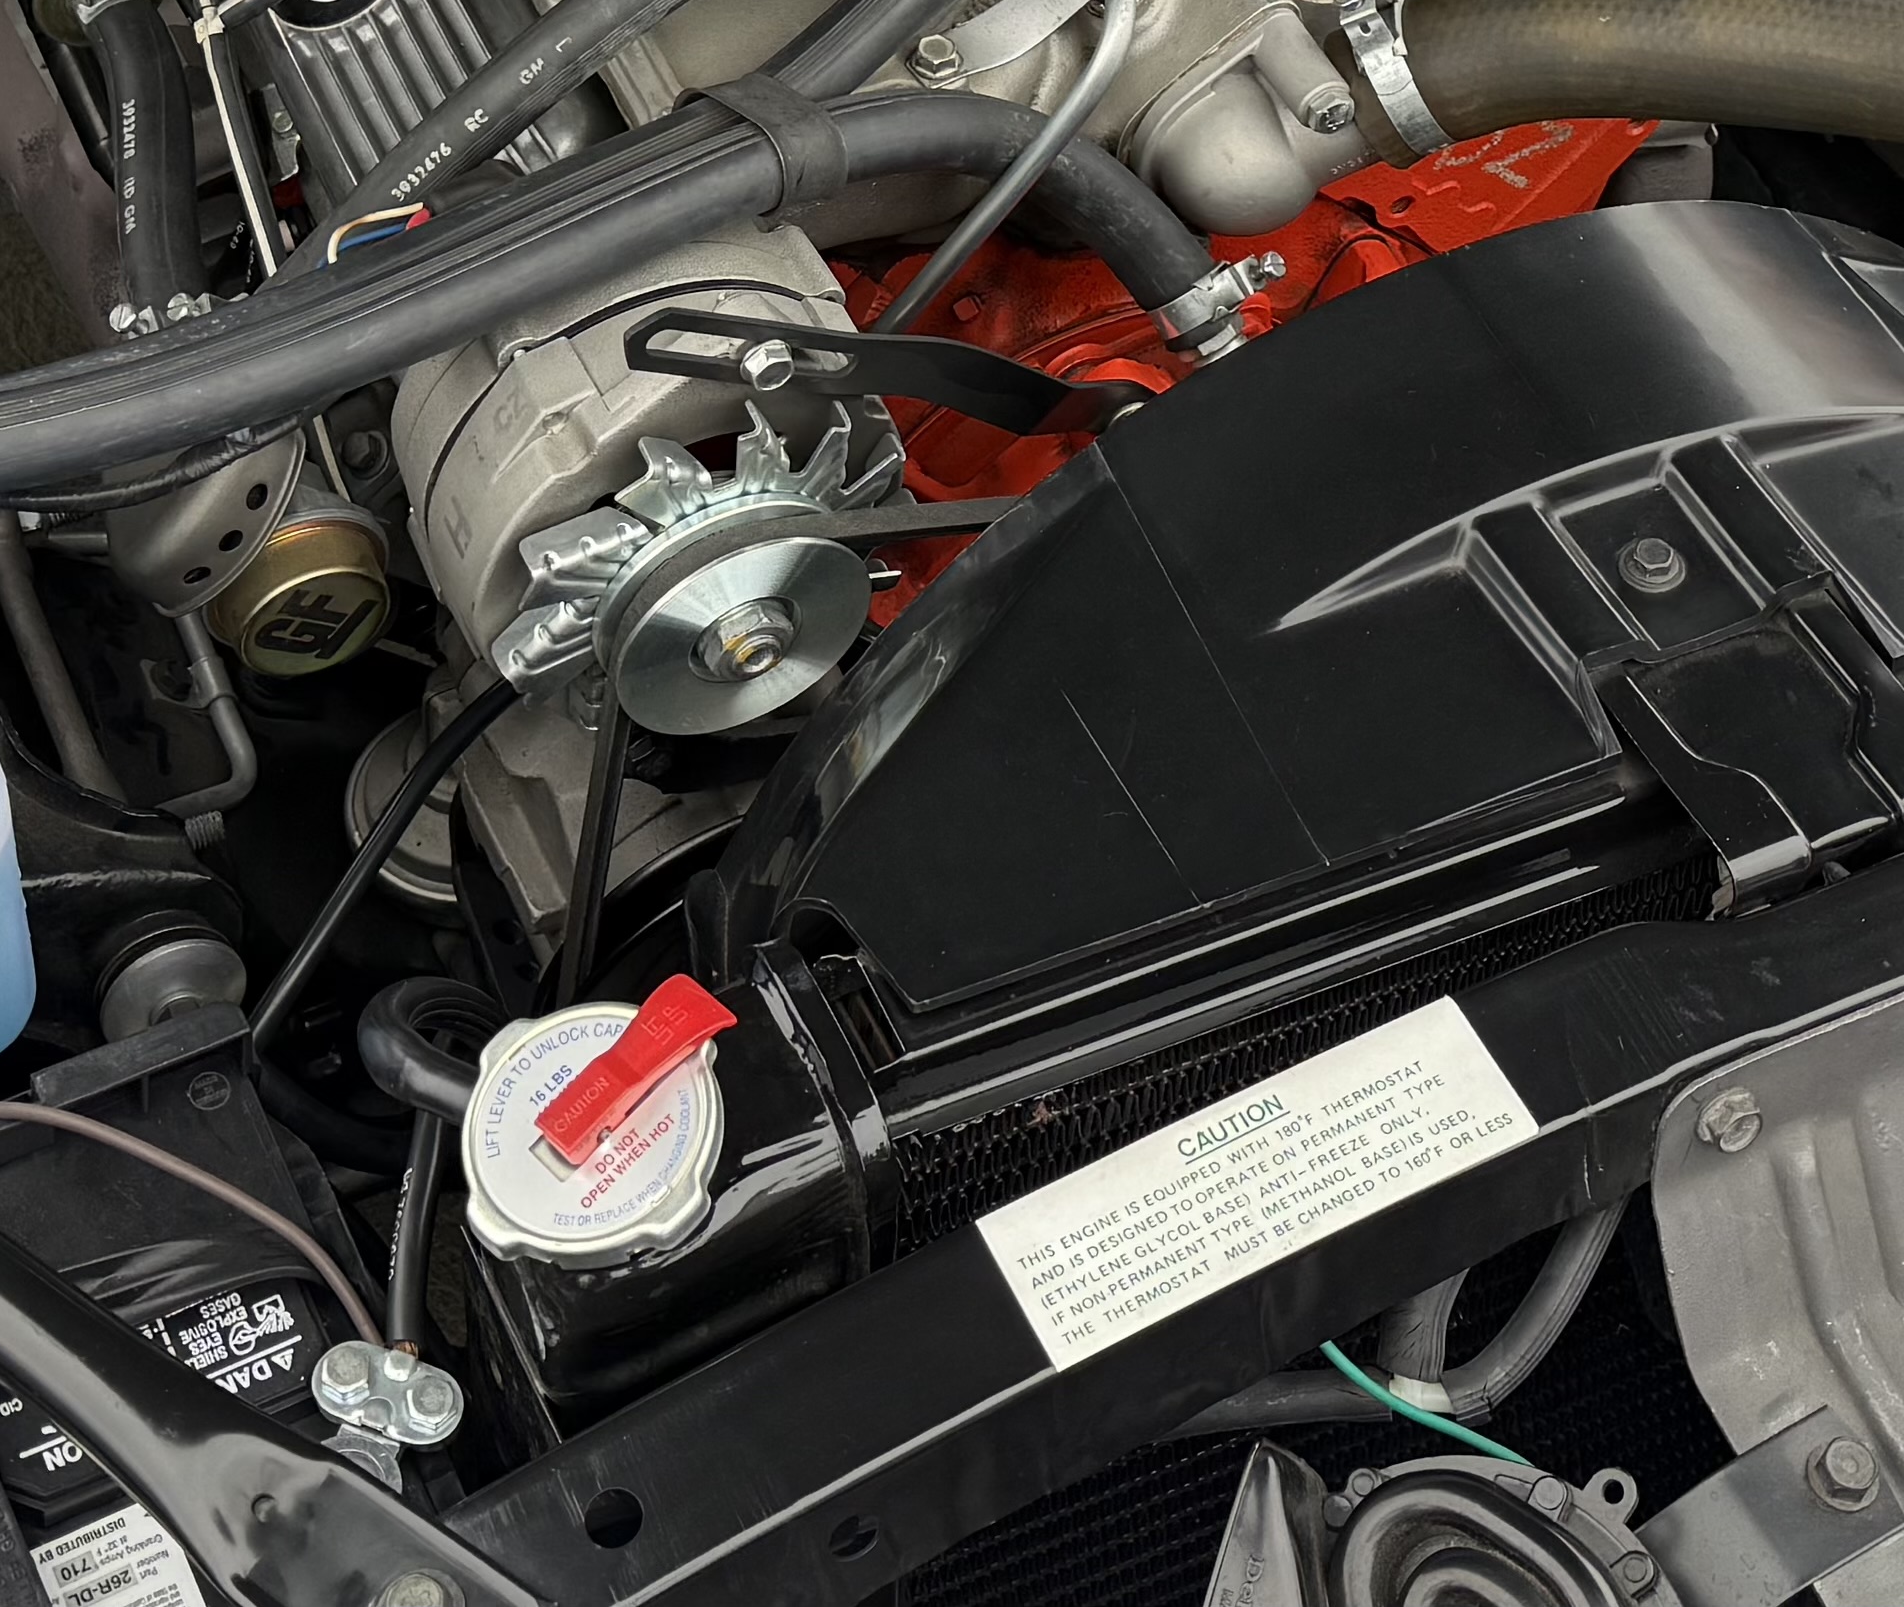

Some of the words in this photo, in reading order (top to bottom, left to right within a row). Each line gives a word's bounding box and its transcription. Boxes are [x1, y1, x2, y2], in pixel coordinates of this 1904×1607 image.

[391, 142, 452, 201] 3932476
[530, 1028, 590, 1061] UNLOCK
[593, 1022, 624, 1037] CAP
[512, 1056, 532, 1080] TO
[528, 1091, 547, 1107] 16
[544, 1064, 573, 1089] LBS
[489, 1076, 517, 1124] LEVER
[553, 1075, 610, 1133] CAUTION
[485, 1128, 501, 1158] LIFT
[1177, 1094, 1283, 1156] CAUTION
[553, 1212, 576, 1226] TEST
[576, 1214, 592, 1226] OR
[594, 1200, 637, 1225] REPLACE
[635, 1179, 663, 1204] WHEN
[658, 1133, 687, 1184] CHANGING
[675, 1089, 691, 1138] COOLANT
[580, 1173, 616, 1209] OPEN
[614, 1142, 651, 1179] WHEN
[647, 1113, 676, 1142] HOT
[595, 1154, 616, 1175] DO
[614, 1128, 641, 1155] NOT
[1016, 1244, 1055, 1269] THIS
[1059, 1209, 1120, 1249] ENGINE
[1123, 1200, 1140, 1216] IS
[1142, 1160, 1221, 1206] EQUIPPED
[1226, 1136, 1269, 1164] WITH
[1320, 1060, 1422, 1116] THERMOSTAT
[1031, 1263, 1065, 1290] AND
[1068, 1252, 1084, 1268] IS
[1086, 1210, 1168, 1259] DESIGNED
[1168, 1198, 1193, 1215] TO
[1194, 1160, 1269, 1204] OPERATE
[1271, 1145, 1297, 1166] ON
[1300, 1096, 1395, 1151] PERMANENT
[1402, 1073, 1445, 1099] TYPE
[1040, 1252, 1132, 1309] (ETHYLENE
[1133, 1220, 1200, 1258] GLYCOL
[1201, 1192, 1251, 1224] BASE)
[1050, 1310, 1064, 1326] IF
[1209, 1214, 1254, 1242] TYPE
[1260, 1166, 1356, 1219] (METHANOL
[1060, 1320, 1095, 1344] THE
[1102, 1259, 1210, 1322] THERMOSTAT
[1223, 1230, 1268, 1261] MUST
[1271, 1218, 1295, 1237] BE
[1297, 1179, 1375, 1224] CHANGED
[1377, 1165, 1400, 1182] TO
[1449, 1131, 1474, 1149] OR
[1474, 1112, 1513, 1137] LESS
[178, 1305, 248, 1344] EXPLOSIVE
[199, 1292, 243, 1319] GASES
[185, 1331, 223, 1355] EYES
[38, 1548, 54, 1564] BY
[54, 1516, 126, 1556] DISTRIBUTED
[59, 1557, 91, 1581] 710
[66, 1569, 131, 1607] 26R-DL
